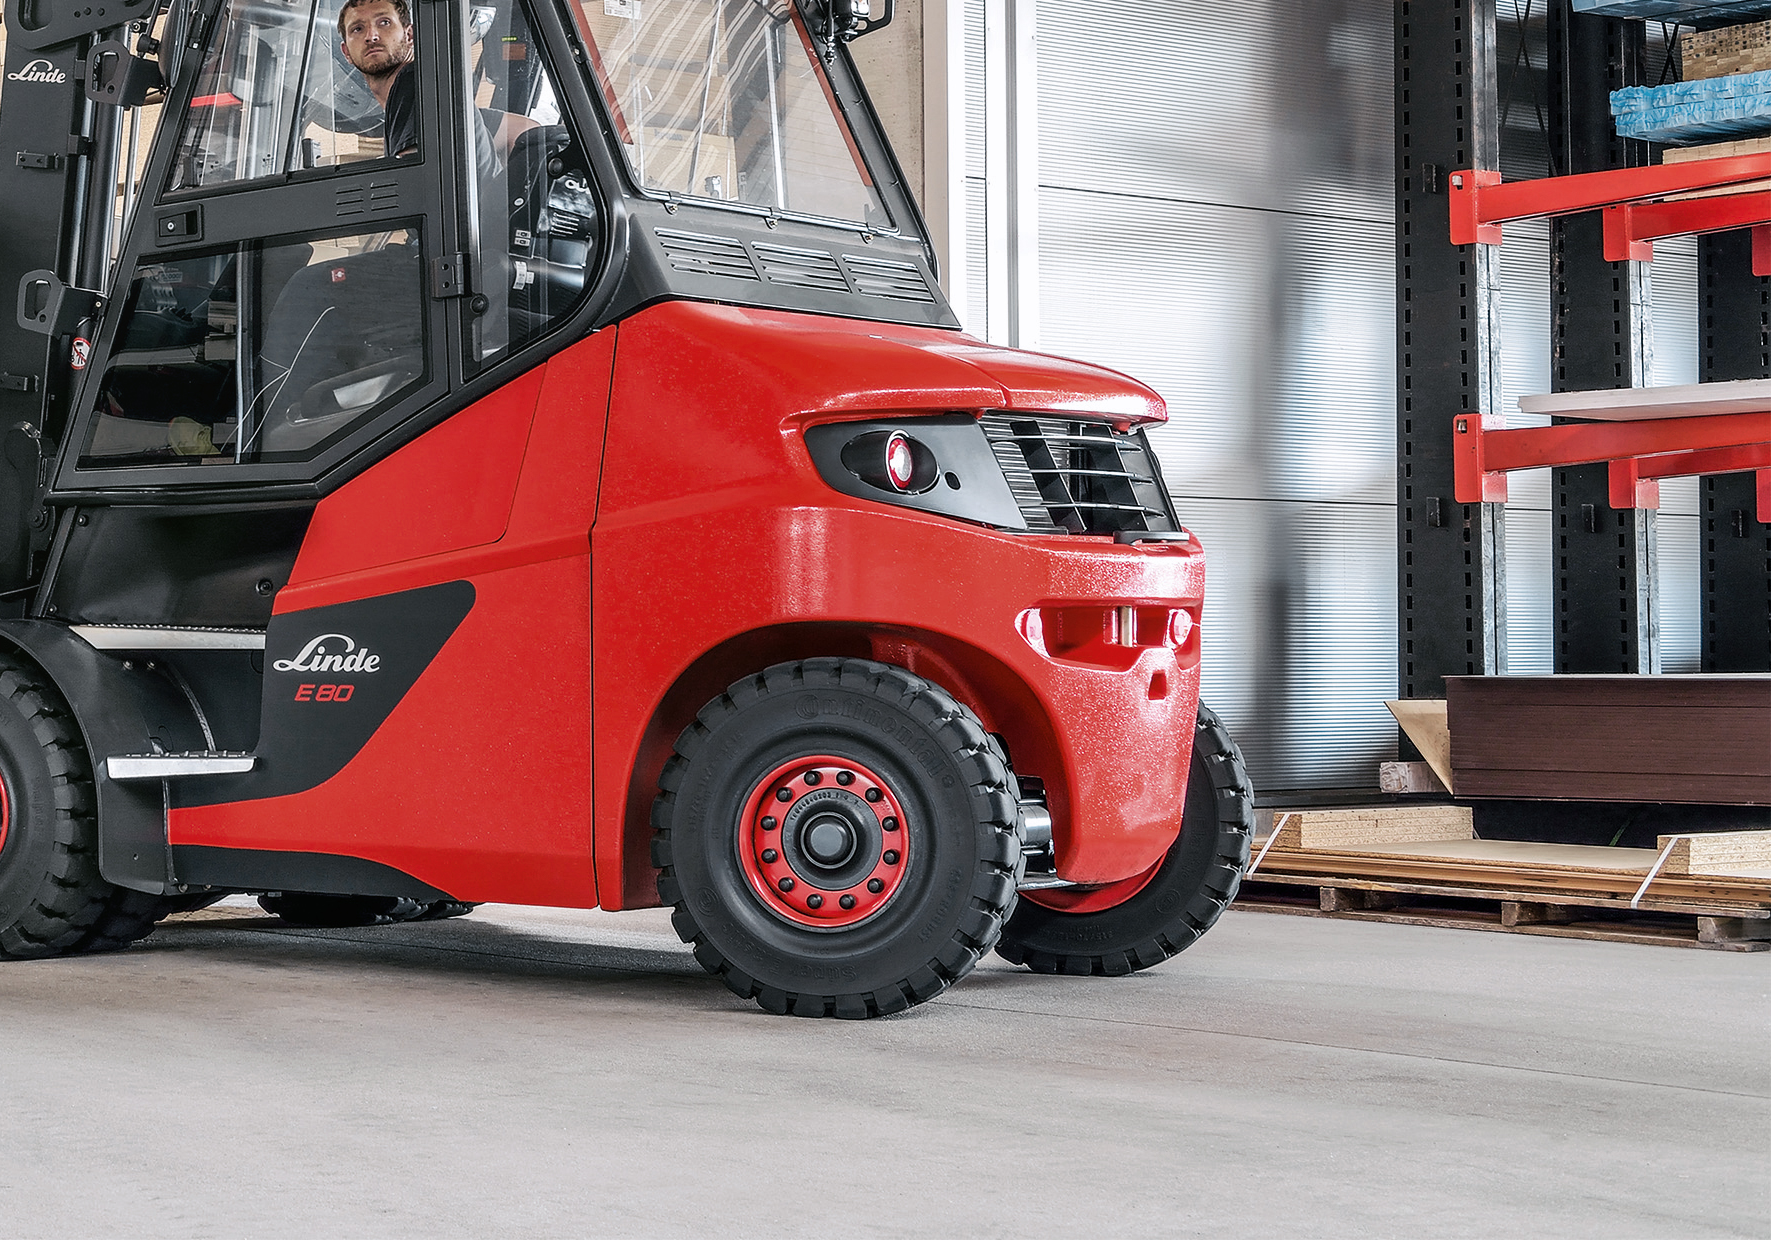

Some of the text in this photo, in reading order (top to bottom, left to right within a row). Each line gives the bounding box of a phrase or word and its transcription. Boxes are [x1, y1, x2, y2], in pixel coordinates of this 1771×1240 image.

[7, 58, 66, 84] Linde
[272, 633, 380, 672] Linde
[294, 683, 355, 702] E 80
